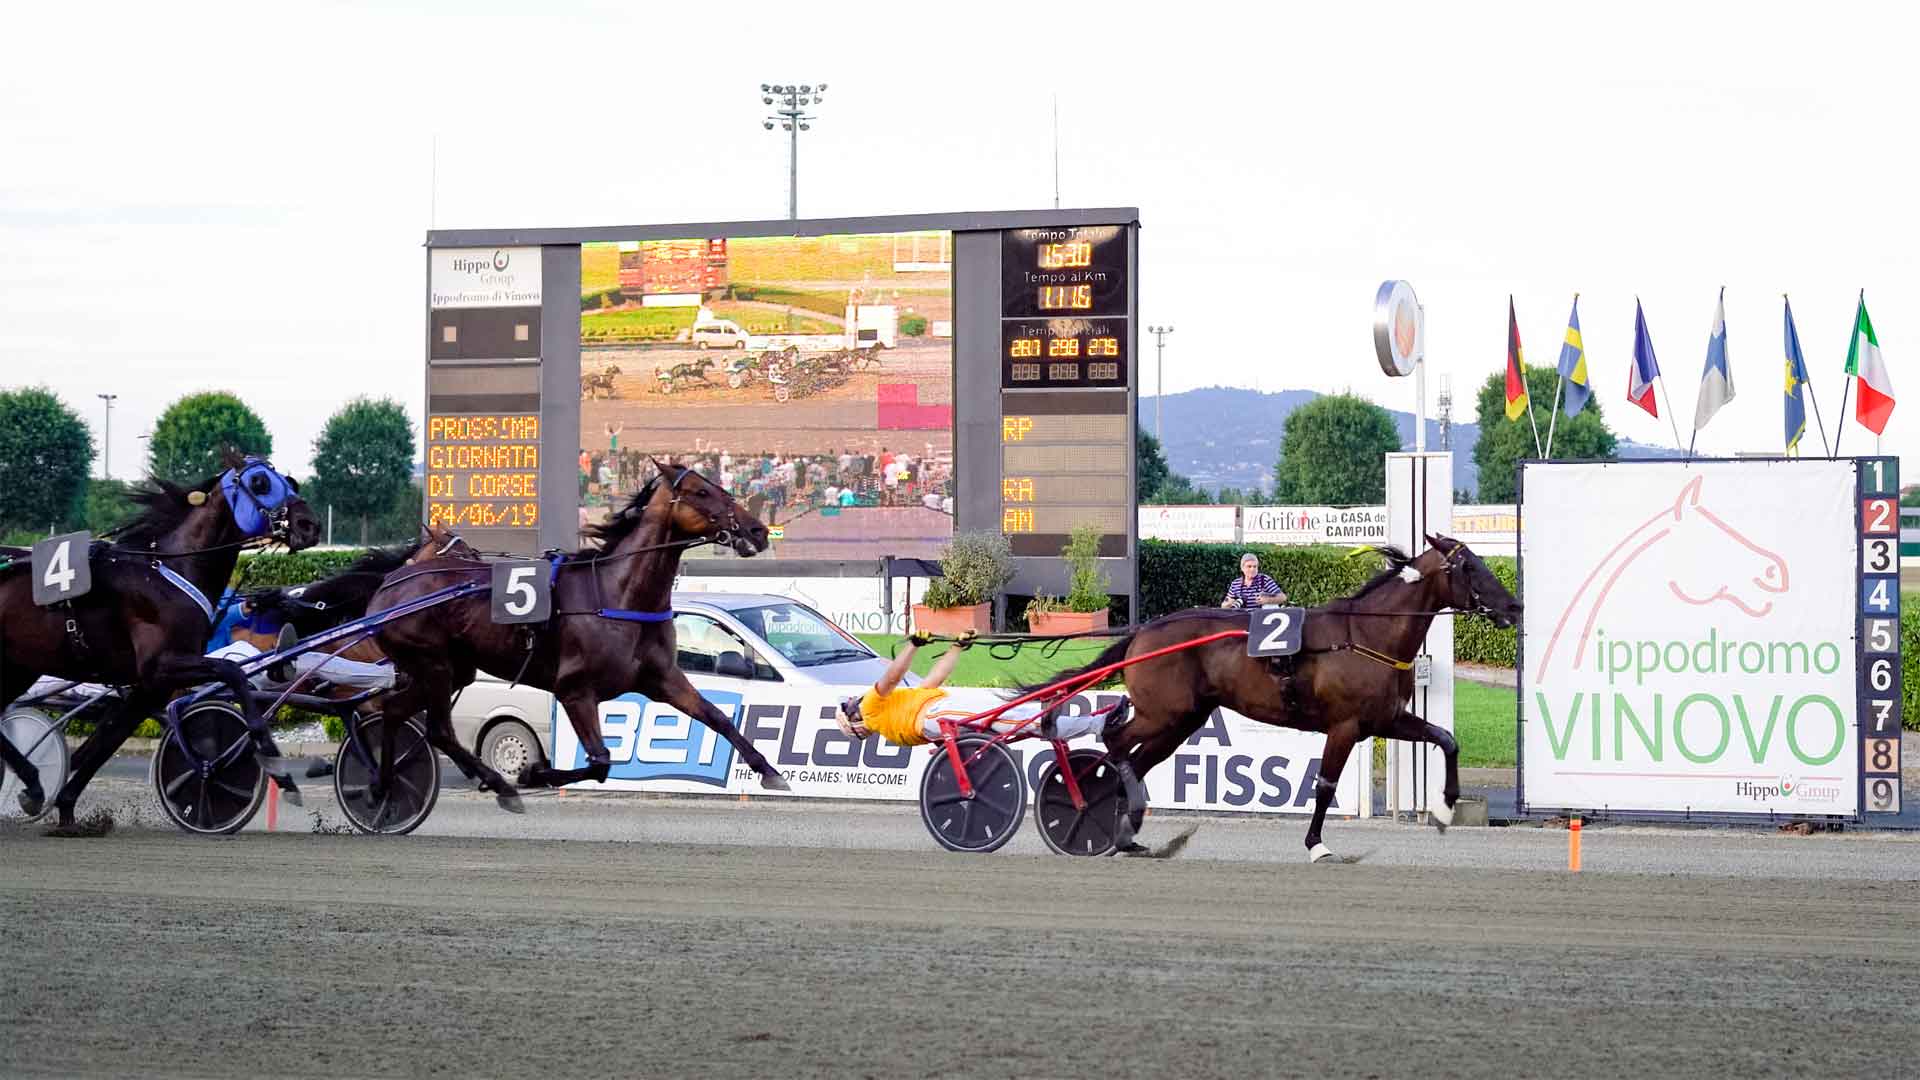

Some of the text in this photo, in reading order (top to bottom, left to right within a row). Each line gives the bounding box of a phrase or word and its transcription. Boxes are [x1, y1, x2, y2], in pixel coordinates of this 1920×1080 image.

[453, 258, 490, 273] Hippo
[1024, 271, 1106, 284] Tempo al Km
[492, 290, 502, 302] di
[504, 290, 540, 301] Vinovo
[430, 416, 538, 440] PROSSIMA
[430, 445, 538, 469] GIORNATA
[429, 474, 537, 497] DI CORSE
[1873, 460, 1884, 492] 1
[429, 503, 537, 525] 24/06/19
[1259, 511, 1321, 530] Grifone
[1326, 512, 1338, 523] La
[1341, 511, 1372, 523] CASA
[1869, 500, 1891, 532] 2
[43, 541, 76, 592] 4
[1870, 540, 1891, 571] 3
[505, 566, 537, 616] 5
[1868, 579, 1891, 611] 4
[1258, 612, 1290, 650] 2
[1870, 619, 1892, 651] 5
[1597, 627, 1840, 685] ippodromo
[1869, 659, 1892, 691] 6
[1535, 692, 1846, 767] VINOVO
[1871, 699, 1893, 732] 7
[1872, 739, 1892, 771] 8
[735, 768, 753, 780] THE
[783, 771, 796, 782] OF
[799, 770, 843, 783] GAMES:
[846, 772, 907, 785] WELCOME!
[1173, 754, 1340, 808] FISSA
[1736, 781, 1840, 802] Hippo Group
[1872, 779, 1893, 811] 9
